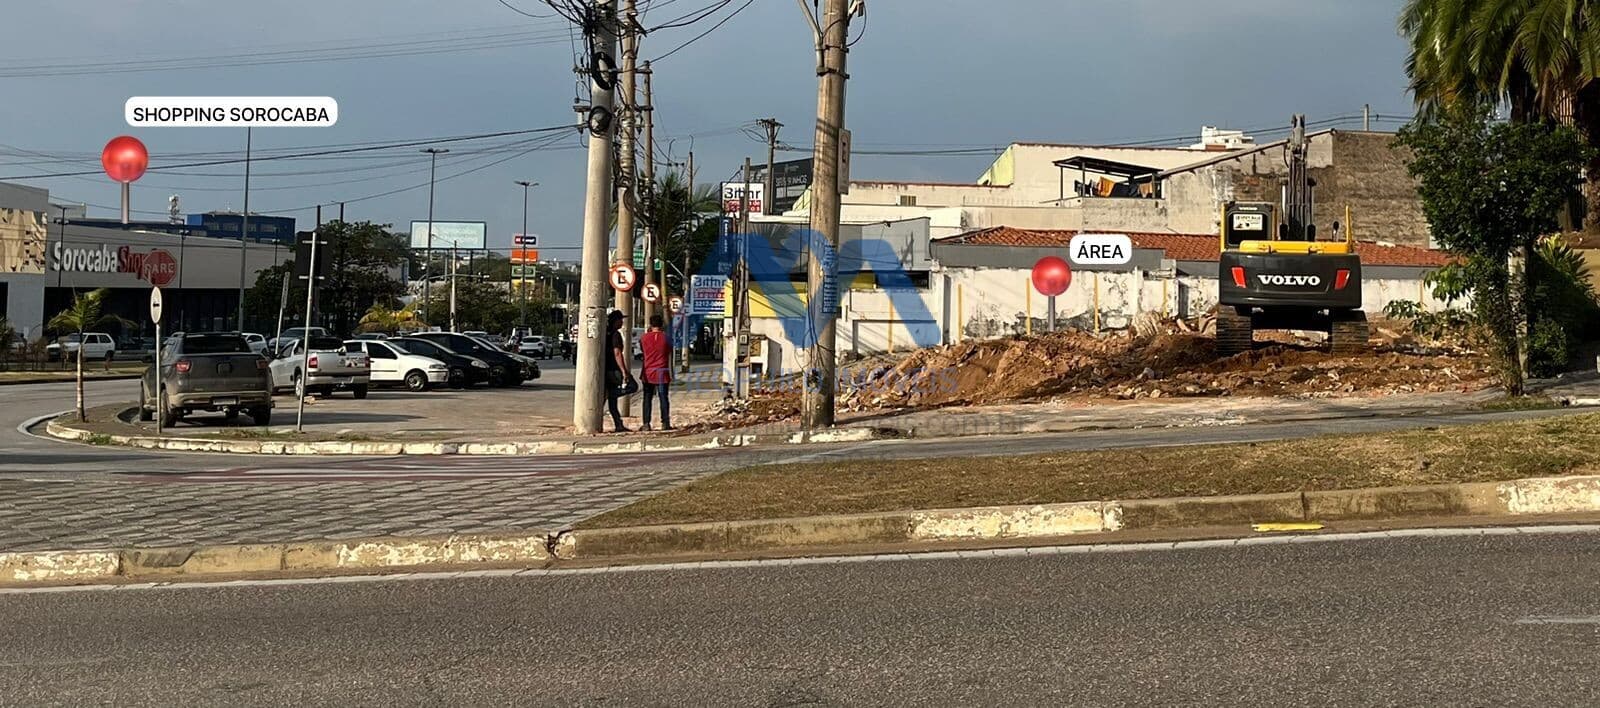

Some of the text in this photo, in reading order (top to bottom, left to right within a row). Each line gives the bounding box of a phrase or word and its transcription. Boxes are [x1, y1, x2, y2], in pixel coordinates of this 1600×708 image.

[53, 241, 118, 273] Sorocaba
[144, 263, 175, 274] PARE
[1257, 274, 1321, 286] VOLVO
